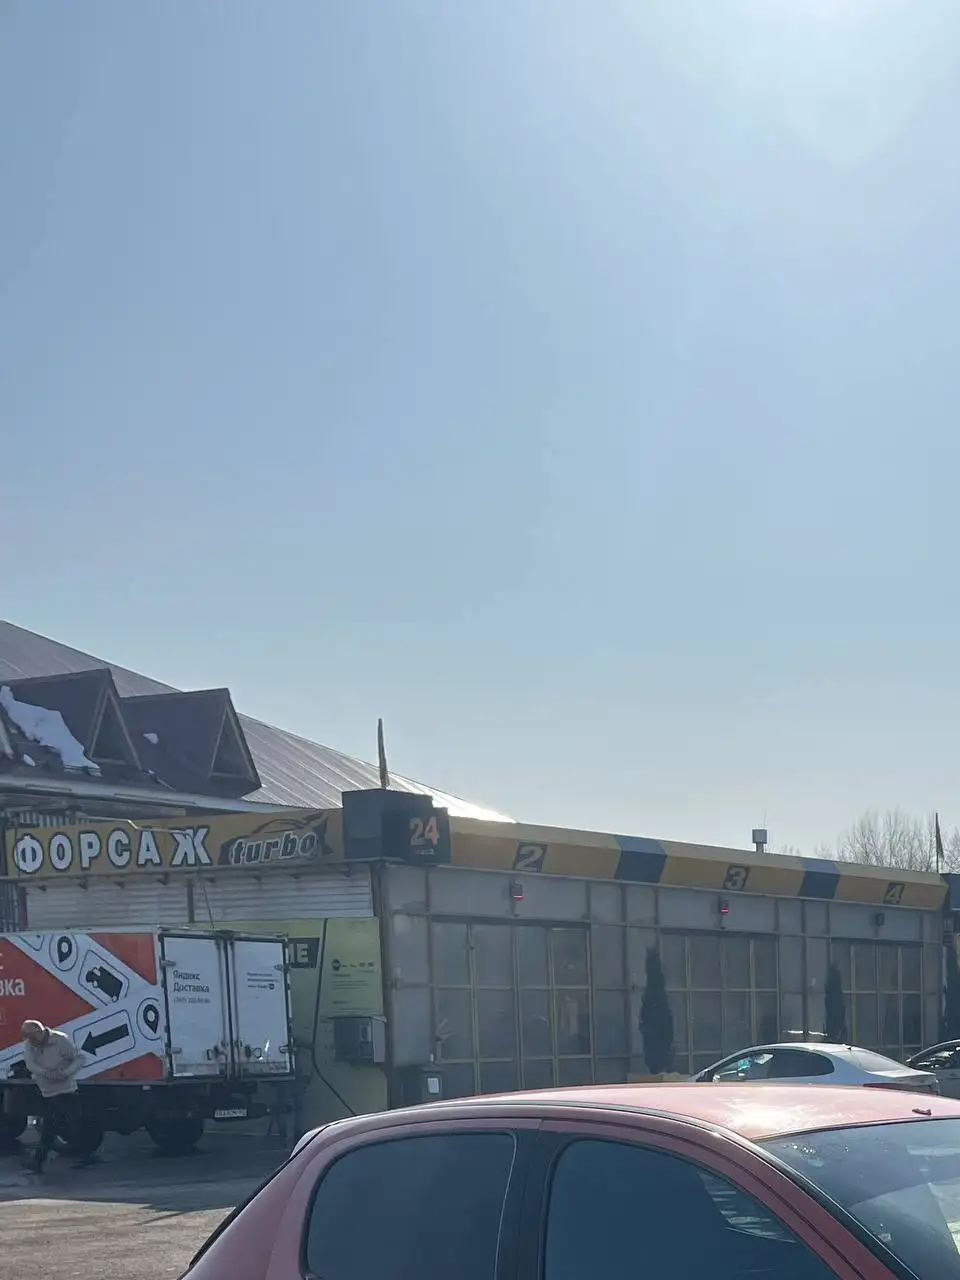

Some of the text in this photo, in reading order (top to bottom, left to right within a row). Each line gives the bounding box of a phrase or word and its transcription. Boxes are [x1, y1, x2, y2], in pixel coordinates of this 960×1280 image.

[409, 816, 439, 846] 24
[13, 825, 318, 875] ФОРСАЖ turbo
[514, 843, 546, 872] 2
[725, 866, 748, 889] 3
[886, 883, 904, 903] 4
[173, 982, 210, 993] Доставка
